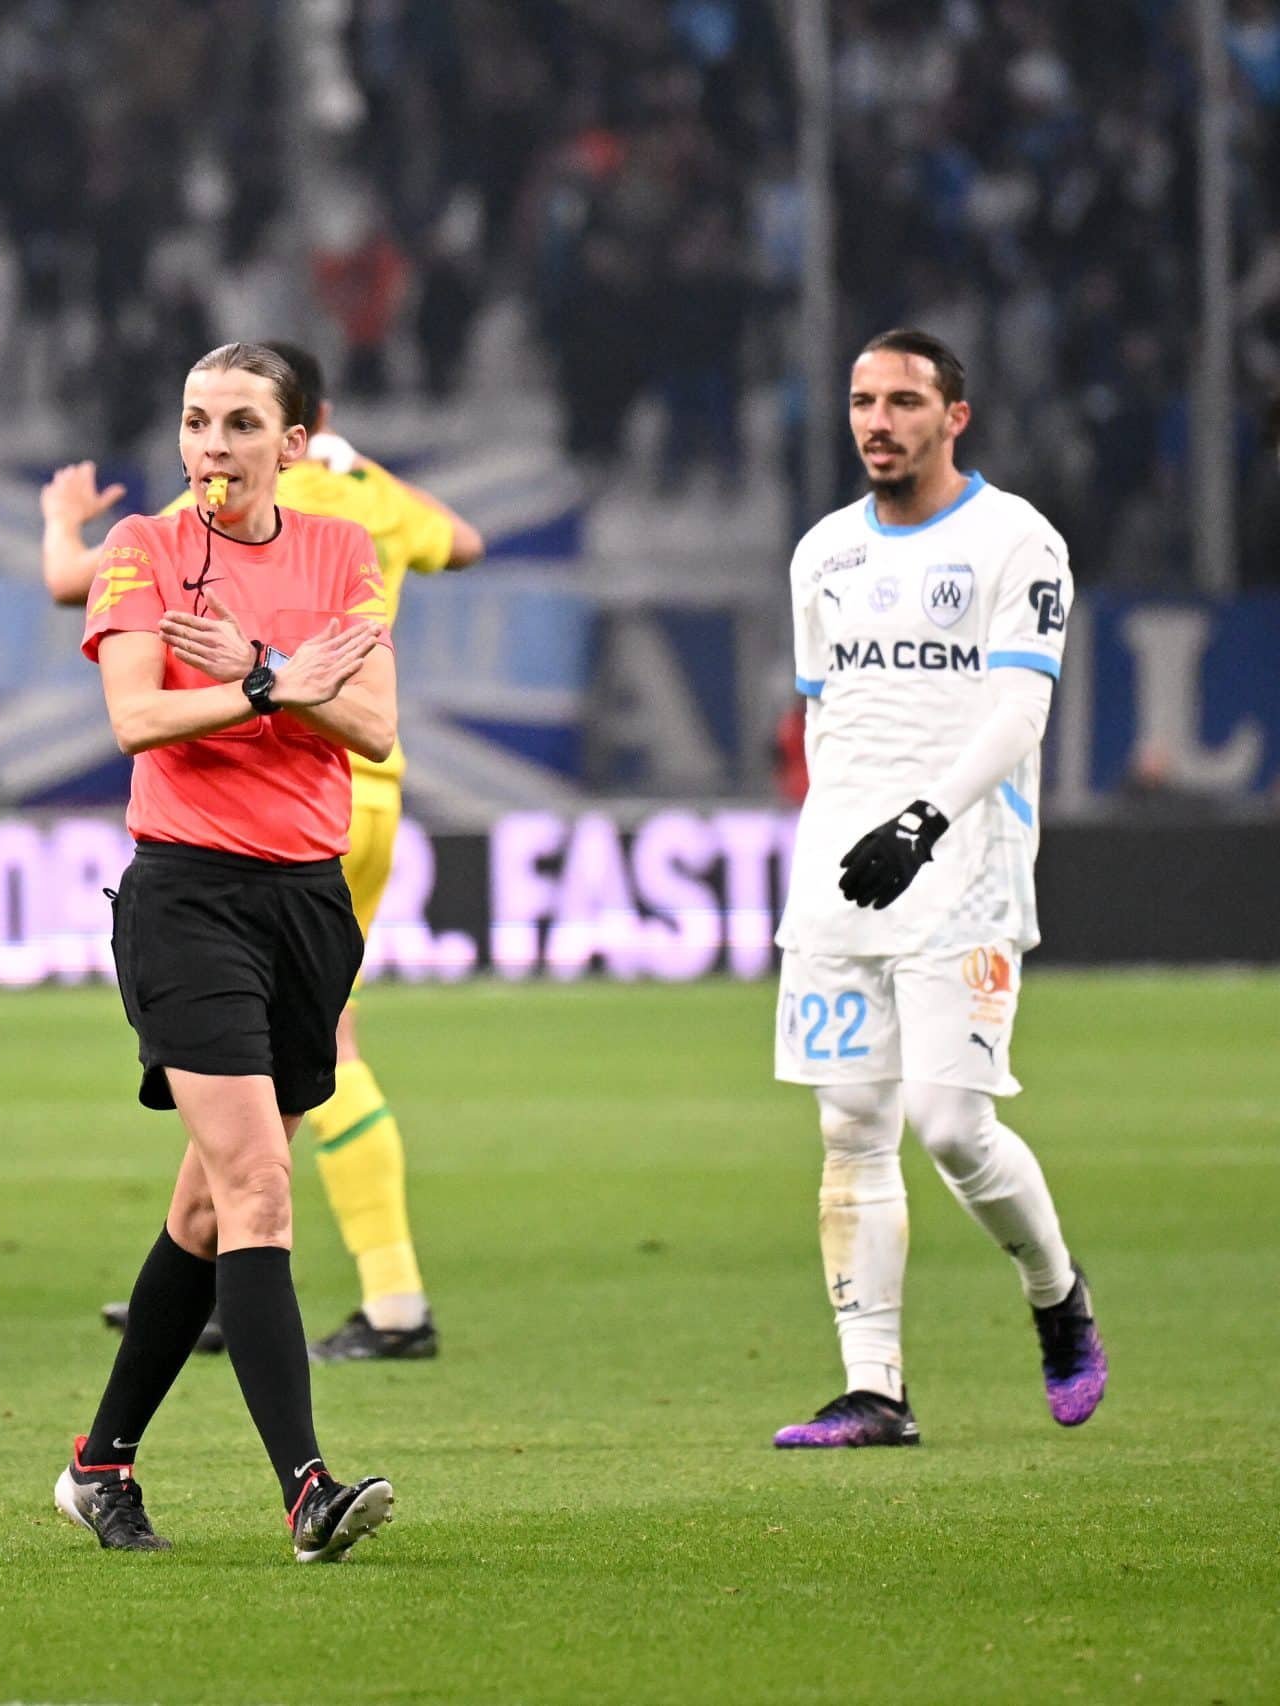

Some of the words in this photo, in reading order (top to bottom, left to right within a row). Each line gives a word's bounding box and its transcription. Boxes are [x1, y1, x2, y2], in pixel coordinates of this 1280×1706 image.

[893, 641, 981, 672] CGM
[489, 808, 799, 982] FAST
[800, 989, 870, 1060] 22
